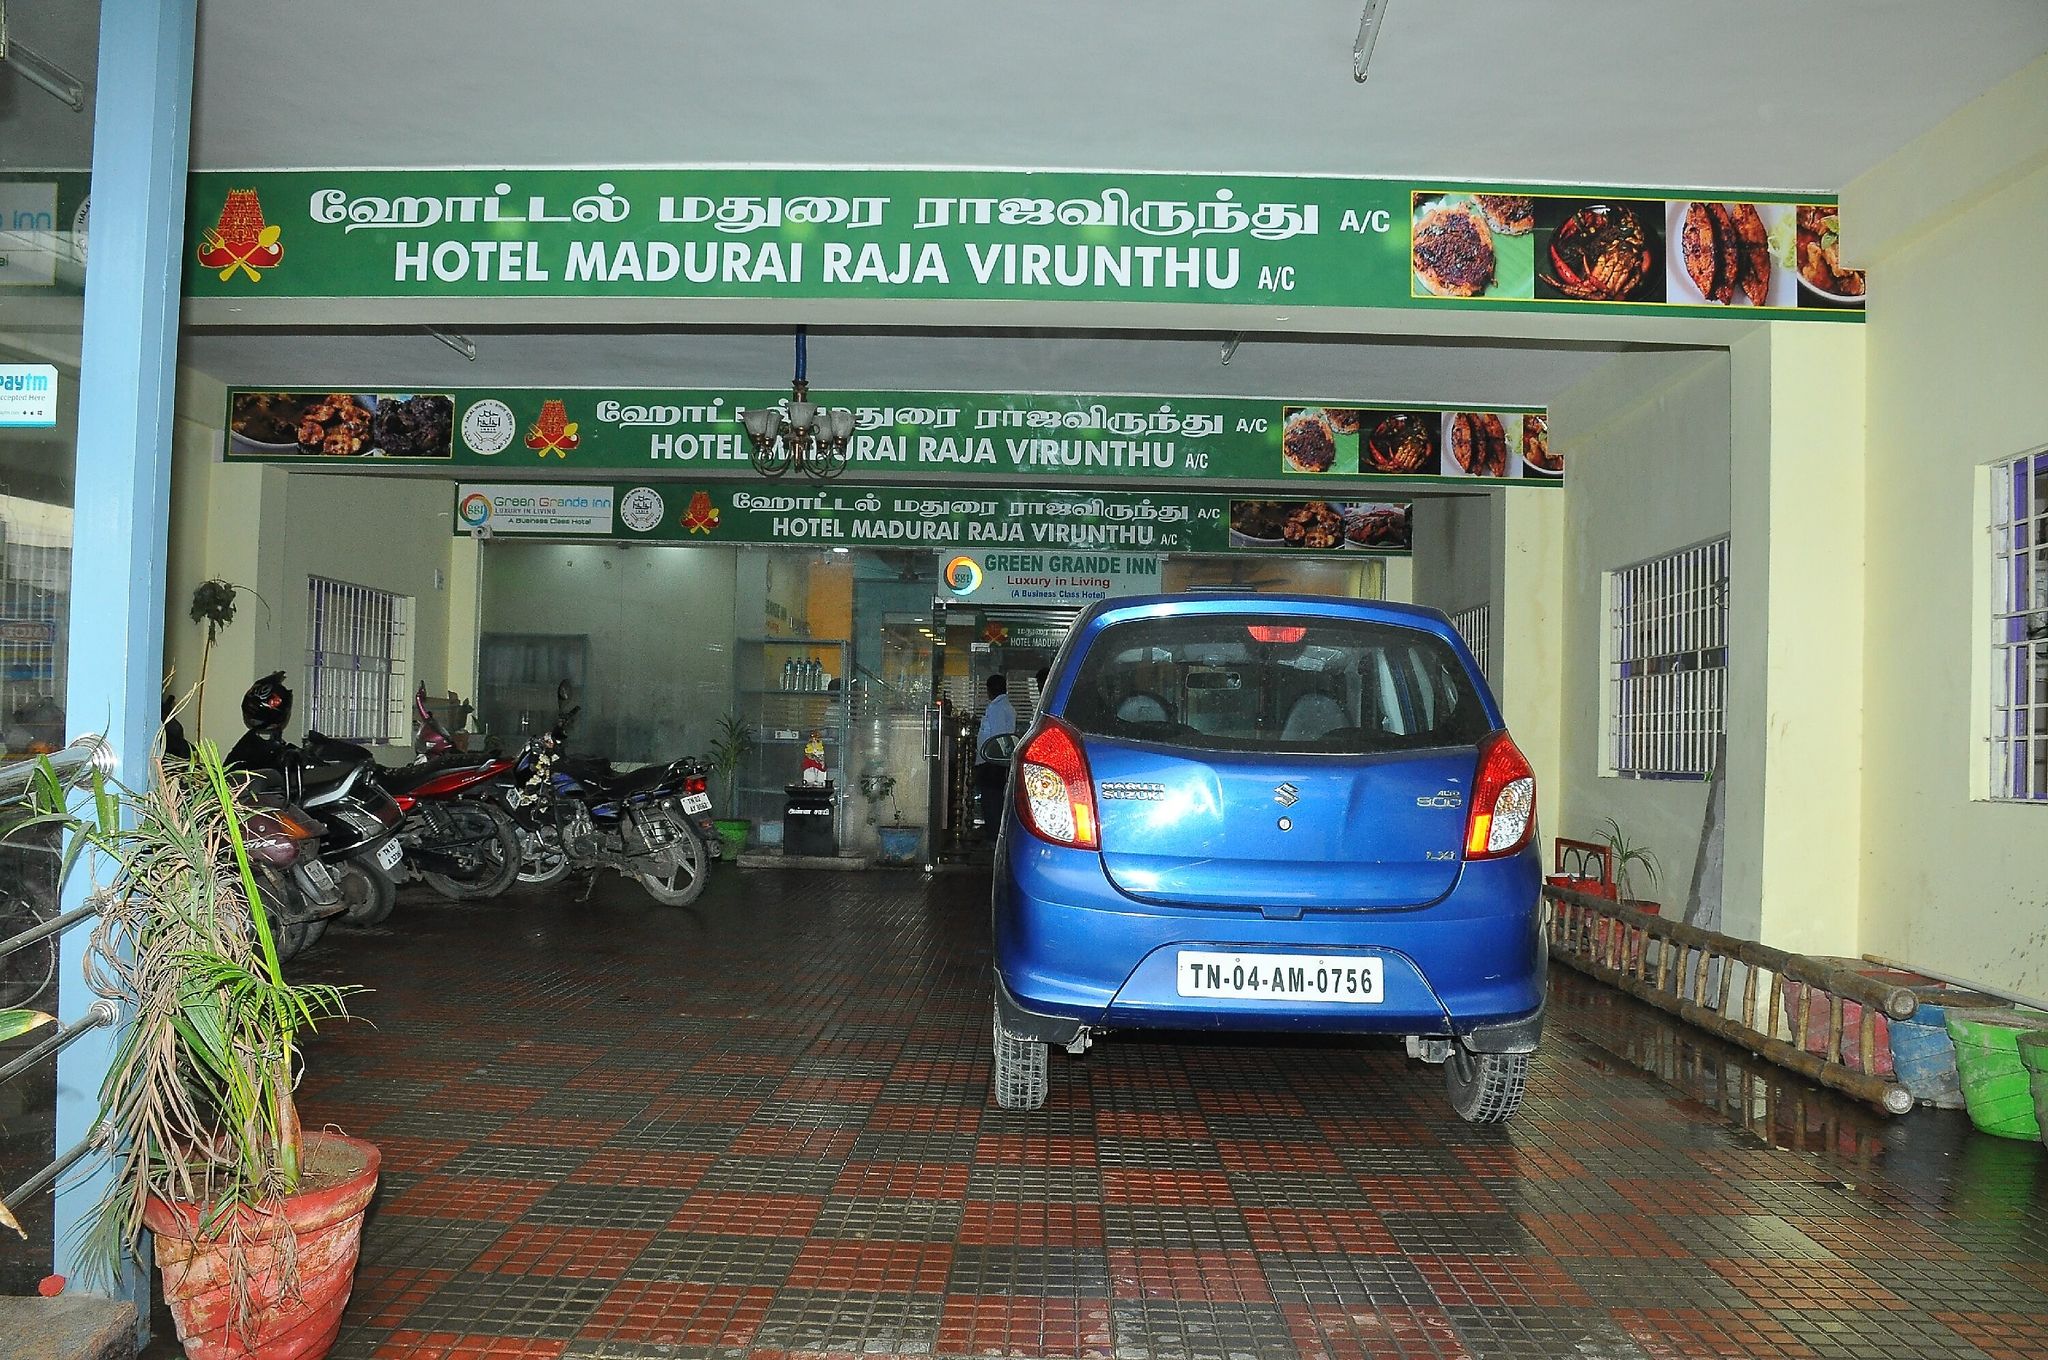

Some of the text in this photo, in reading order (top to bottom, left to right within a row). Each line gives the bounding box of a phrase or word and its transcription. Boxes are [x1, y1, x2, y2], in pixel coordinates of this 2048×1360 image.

[310, 183, 1390, 240] ஹோட்டல் மதுரை ராஜவிருந்து A/C
[395, 241, 1295, 293] HOTEL MADURAI RAJA VIRUNTHU A/C
[974, 404, 1224, 438] ராஜவிருந்து
[1235, 418, 1268, 434] A/C
[651, 434, 749, 460] HOTEL
[918, 437, 997, 464] RAJA
[1005, 439, 1175, 468] VIRUNTHU
[1185, 453, 1209, 469] A/C
[494, 496, 536, 507] Green
[539, 497, 588, 508] Grande
[732, 491, 1221, 523] ஹோட்டல் மதுரை ராஜவிருந்து A/C
[773, 517, 1178, 546] HOTEL MADURAI RAJA VIRUNTHU A/C
[984, 554, 1158, 575] GREEN GRANDE INN
[1007, 576, 1110, 589] Luxury in Living
[1010, 590, 1106, 600] (A Business Class Hotel)
[1010, 637, 1031, 647] HOTEL
[1102, 782, 1166, 791] MARUTI
[1102, 790, 1165, 800] SUZUKI
[1190, 964, 1373, 994] TN-04-AM-0756
